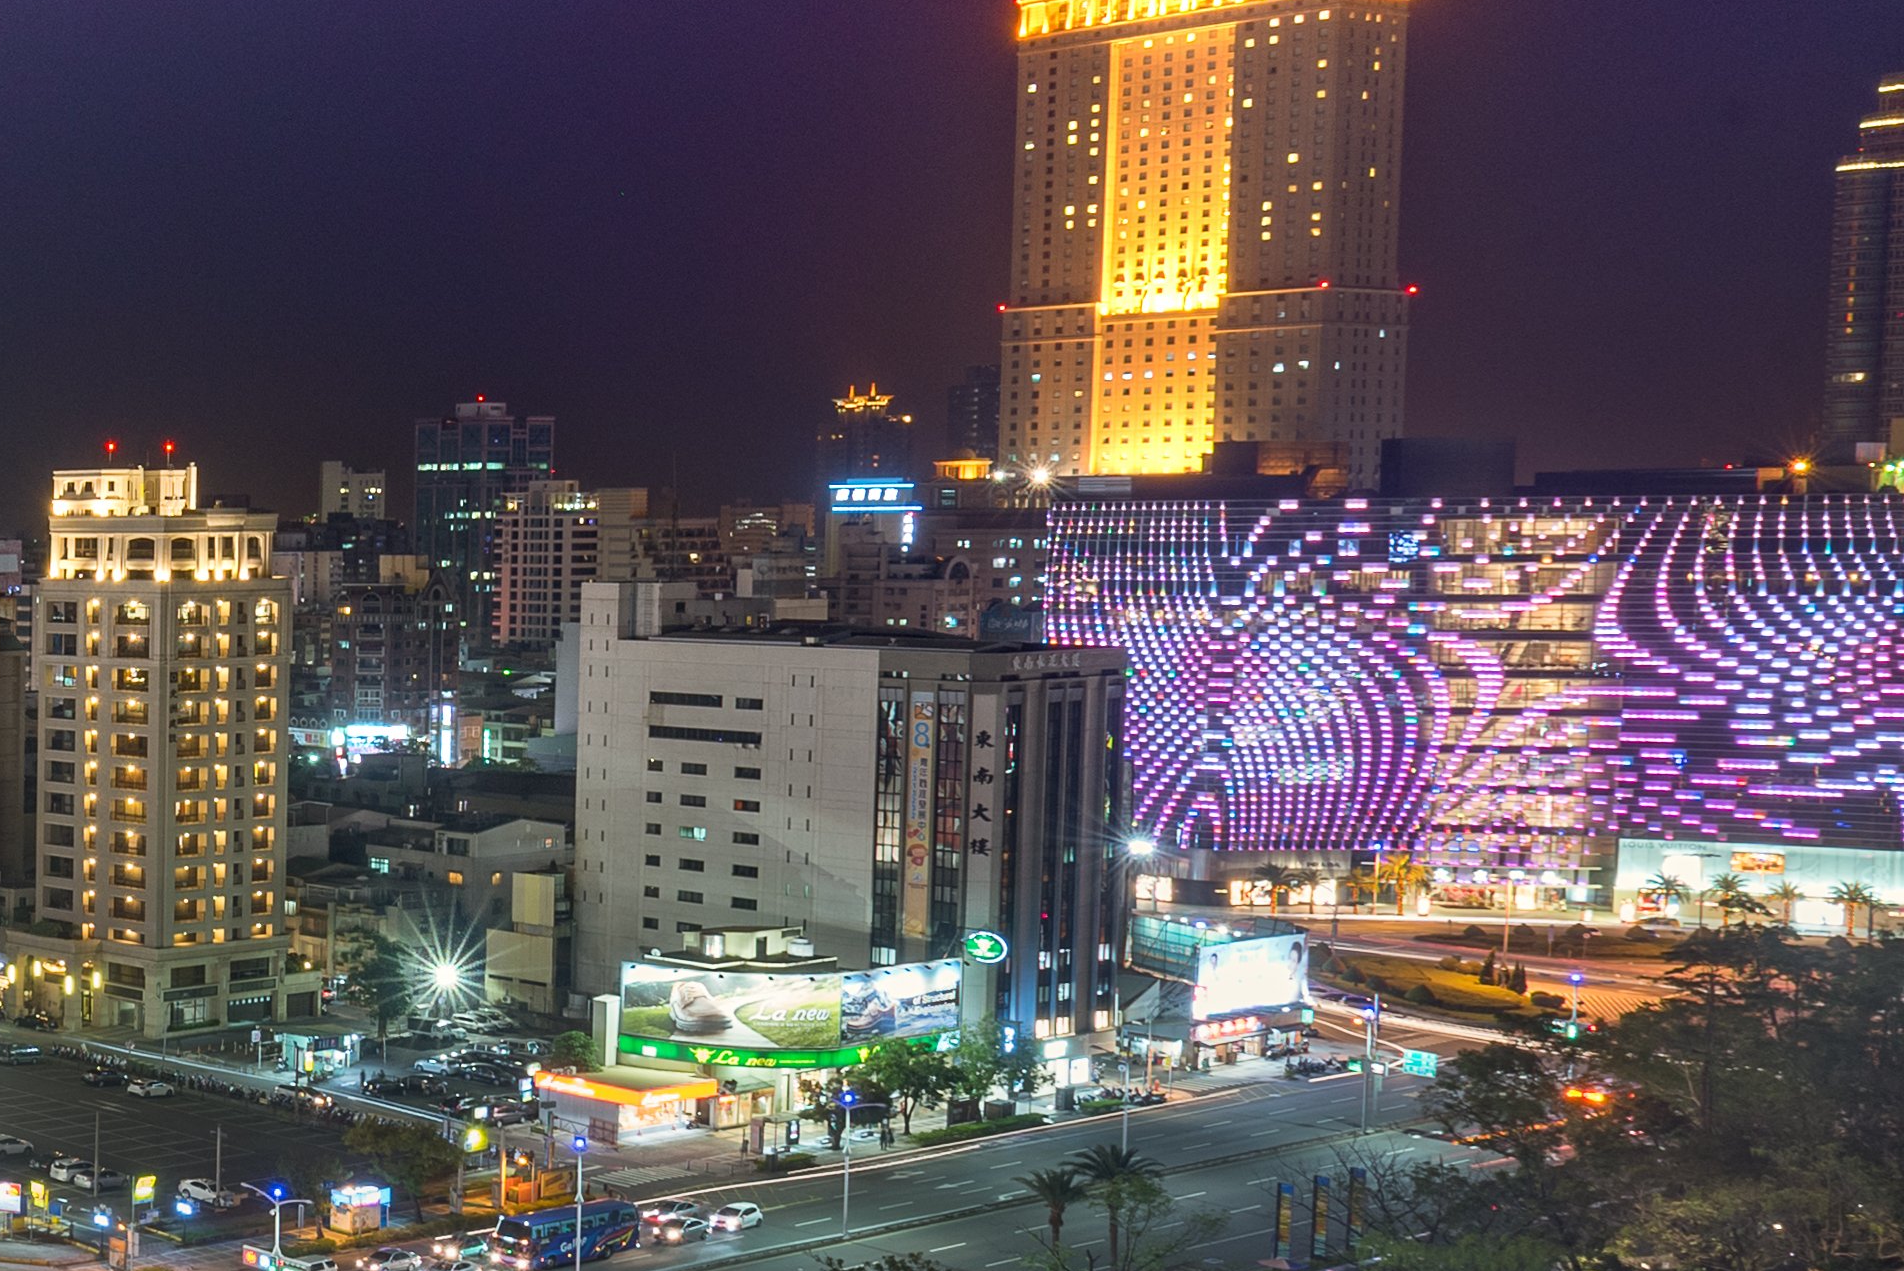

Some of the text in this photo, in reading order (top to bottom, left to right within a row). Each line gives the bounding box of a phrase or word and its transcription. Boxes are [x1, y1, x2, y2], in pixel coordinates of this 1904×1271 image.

[970, 730, 994, 856] 東南大樓
[749, 1004, 830, 1021] La new
[713, 1050, 776, 1067] La new
